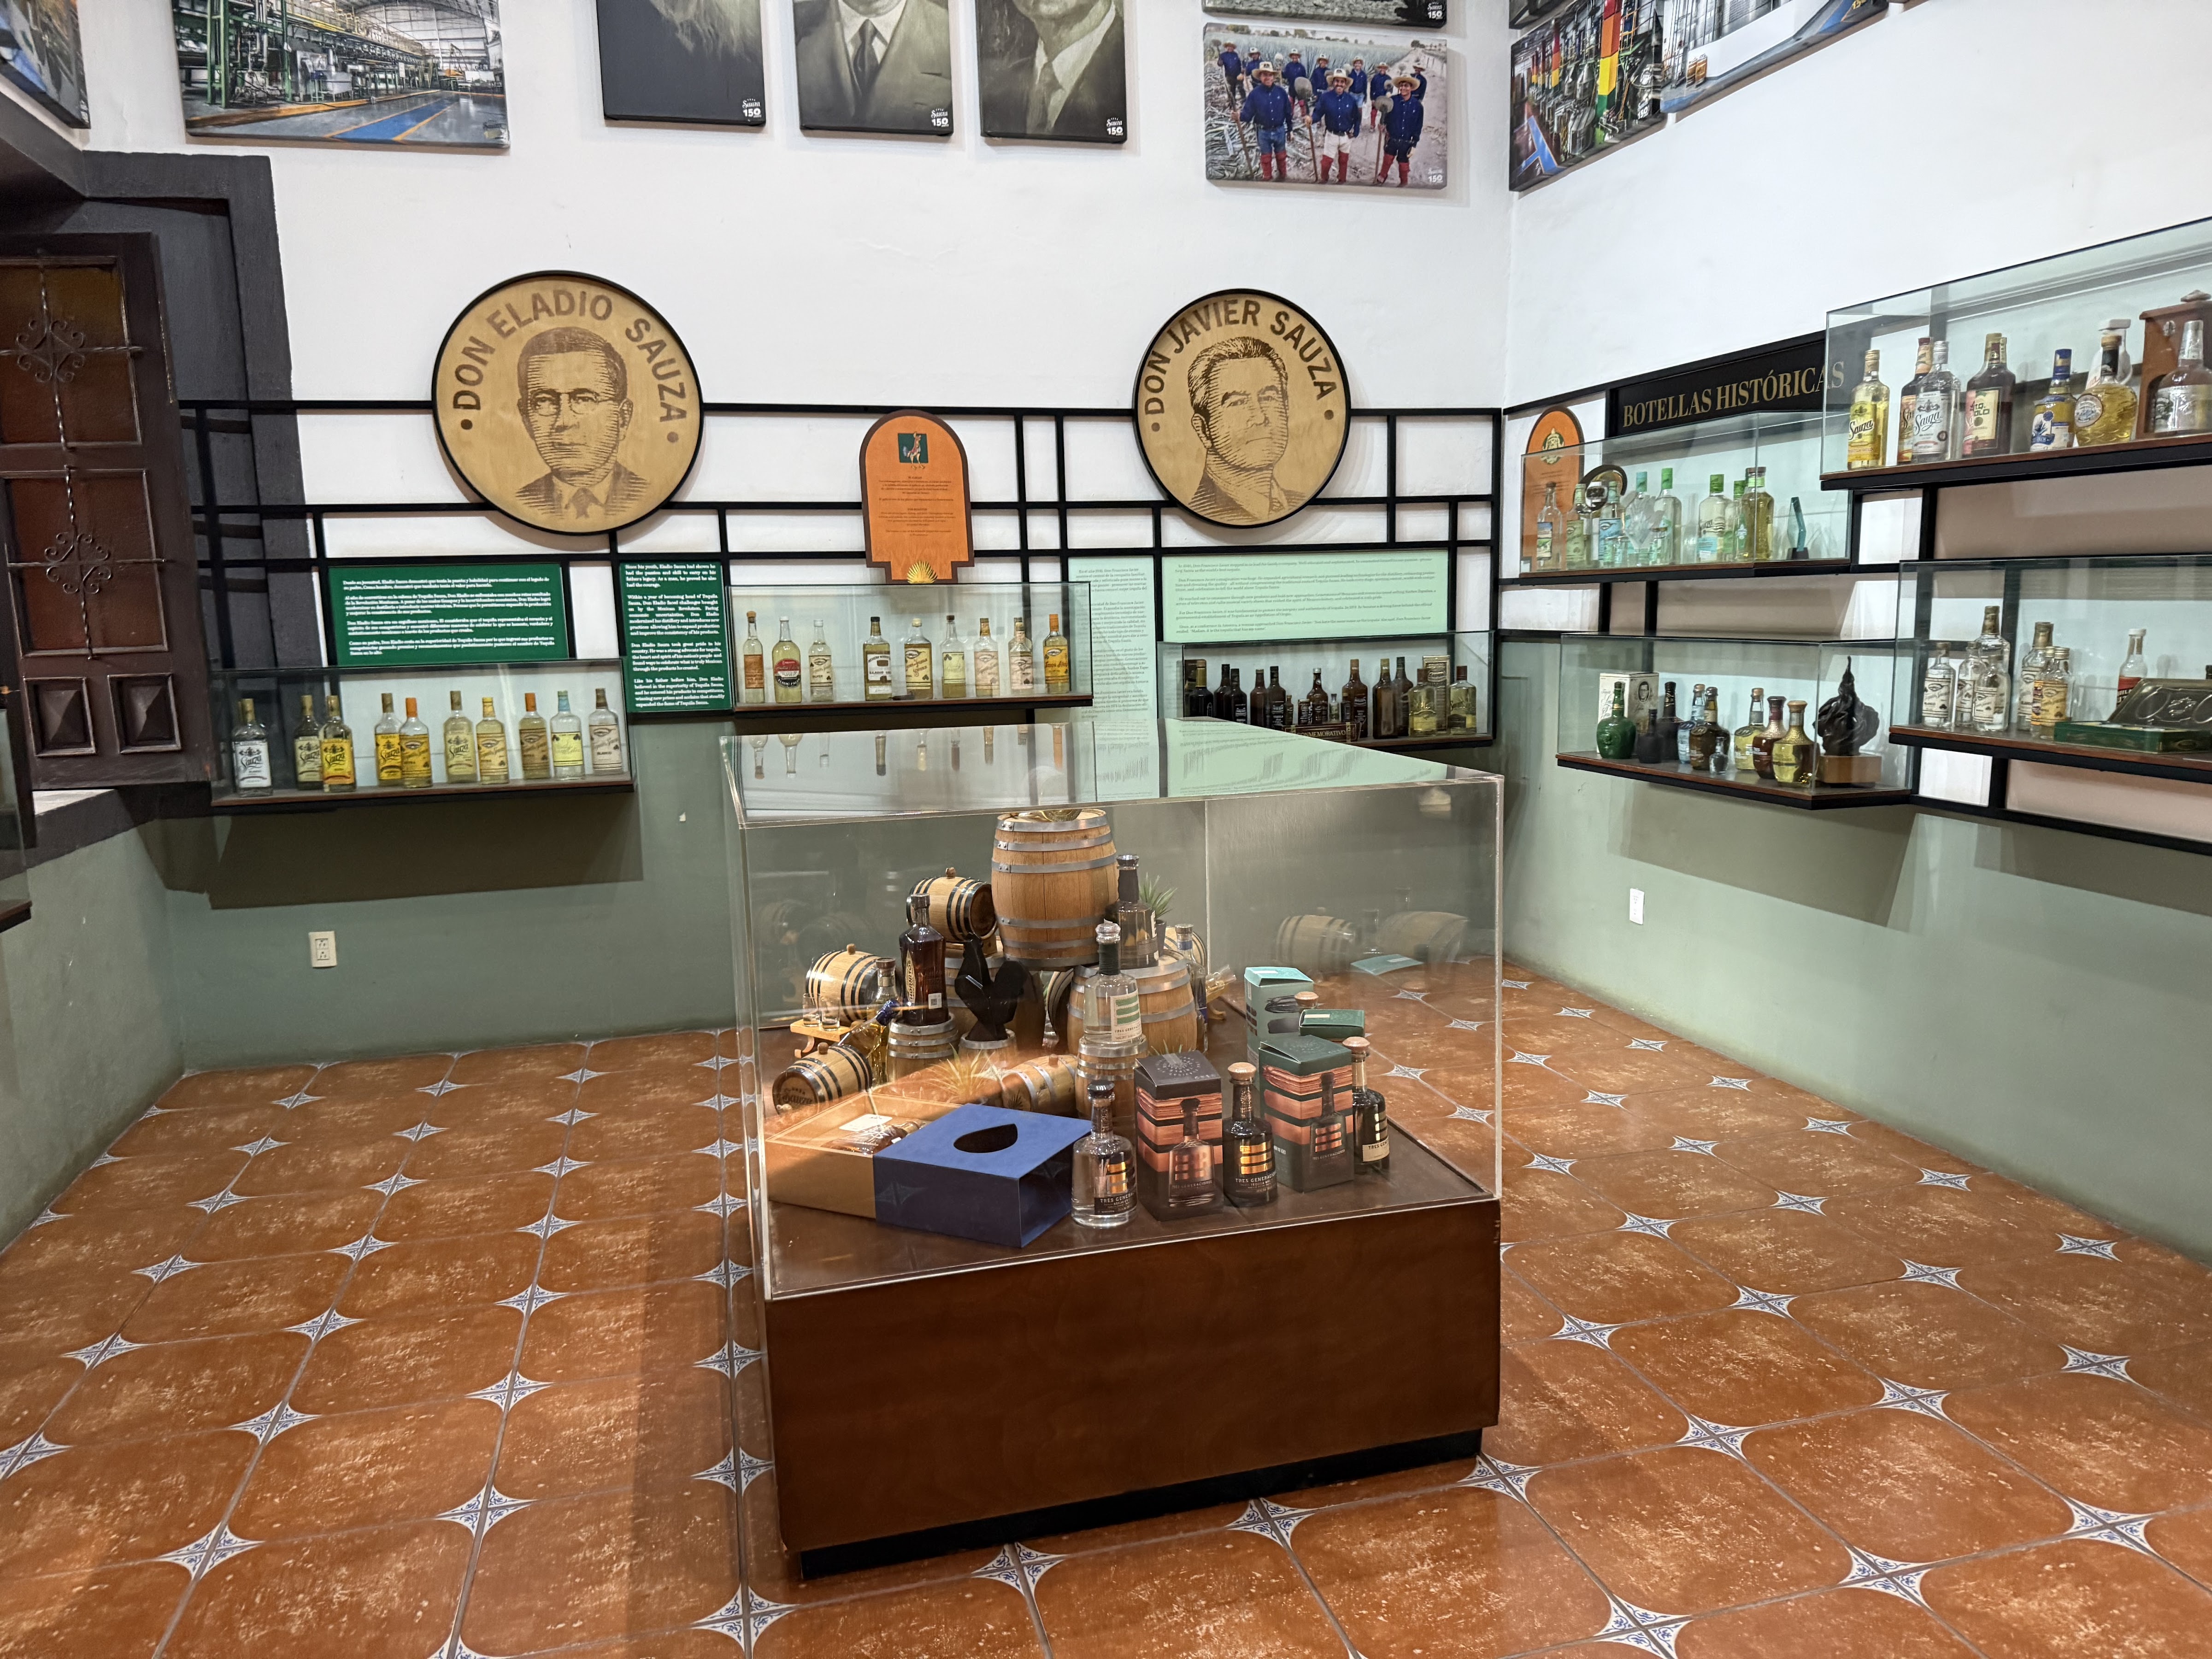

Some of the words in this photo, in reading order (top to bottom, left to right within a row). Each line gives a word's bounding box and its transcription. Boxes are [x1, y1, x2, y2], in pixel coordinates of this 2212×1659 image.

[1428, 10, 1442, 18] 150
[743, 108, 761, 117] 150
[1637, 106, 1648, 120] 150
[932, 118, 948, 126] 150
[1107, 127, 1123, 135] 150
[453, 336, 496, 411] DON
[486, 289, 613, 339] ELADIO
[625, 318, 687, 423] SAUZA
[1144, 350, 1171, 415] DON
[1166, 299, 1261, 354] JAVIER
[1270, 310, 1337, 400] SAUZA
[1623, 389, 1712, 428] BOTELLAS
[1716, 361, 1844, 411] HISTÓRICAS
[1848, 420, 1874, 440] Sauza
[1913, 411, 1942, 436] Sauza
